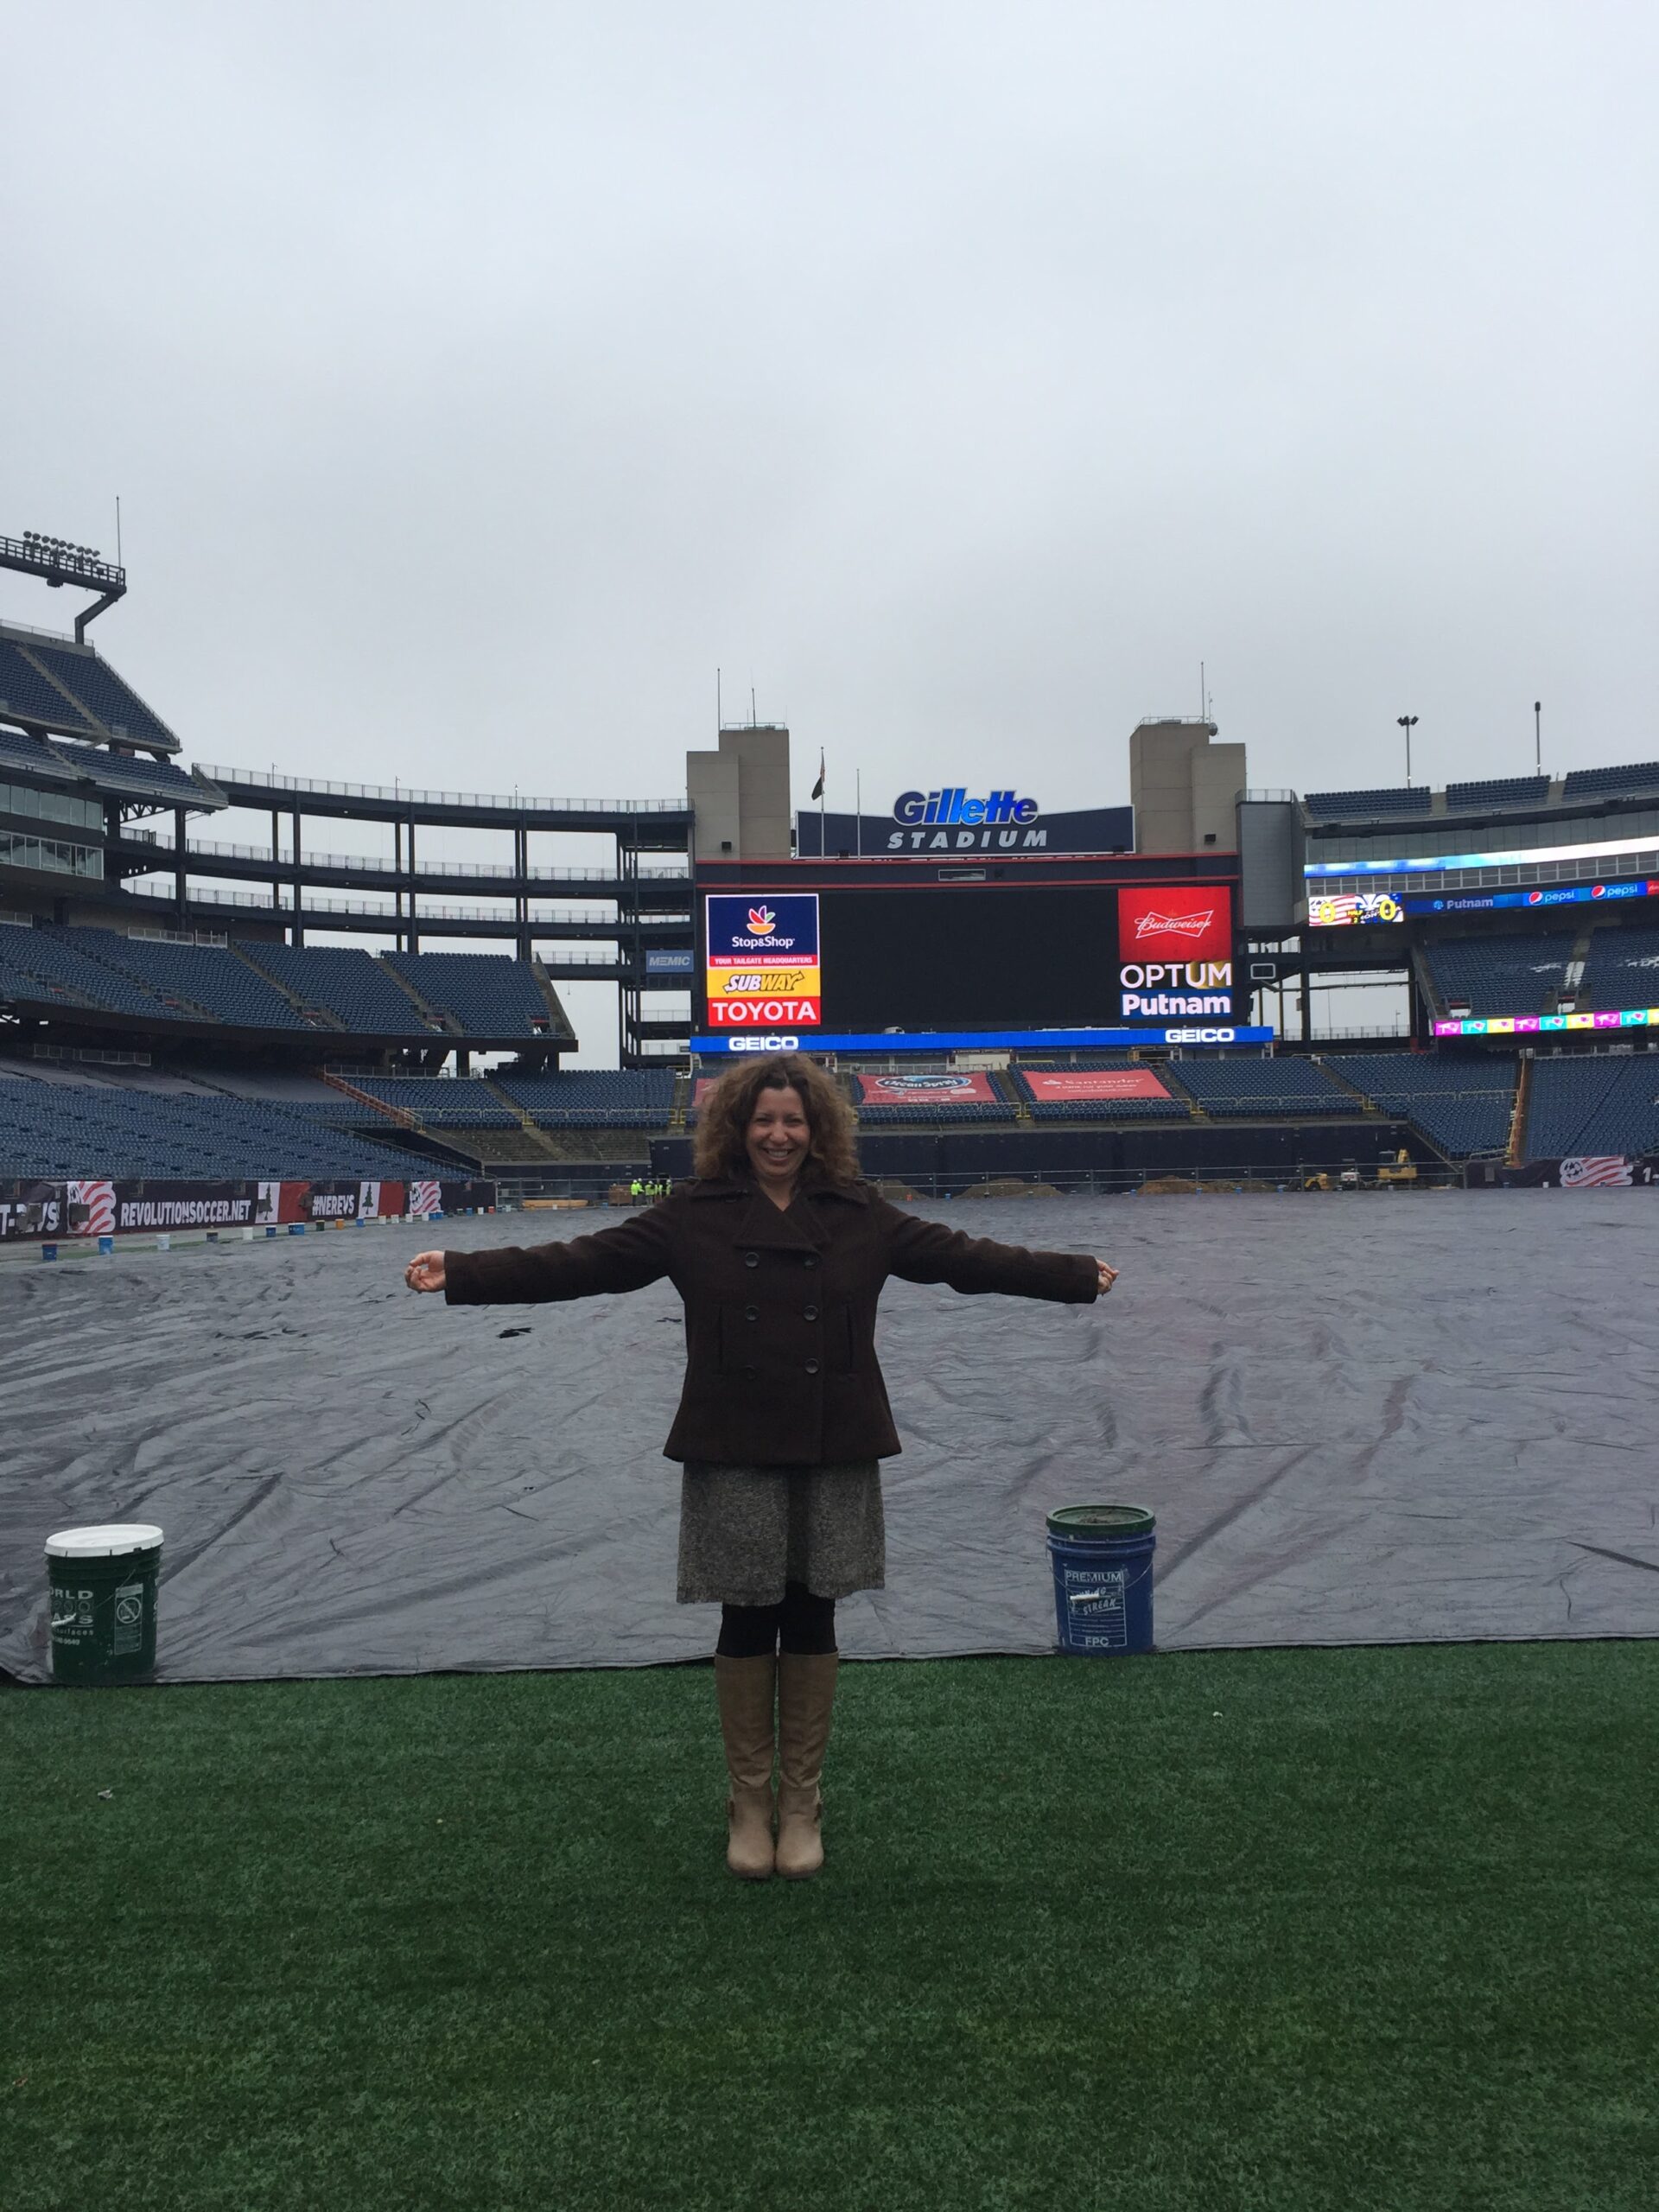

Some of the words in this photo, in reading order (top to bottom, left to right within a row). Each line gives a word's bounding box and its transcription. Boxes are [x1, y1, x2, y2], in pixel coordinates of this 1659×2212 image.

[893, 788, 1038, 825] Gillette
[887, 830, 1047, 849] STADIUM
[1545, 890, 1574, 903] pepsi
[1607, 884, 1637, 898] pepsi
[1446, 899, 1493, 910] Putnam
[1135, 917, 1211, 931] Budweiser
[732, 936, 794, 949] Stop&Shop
[649, 956, 690, 967] MEMIC
[723, 971, 804, 994] SUBWAY
[1120, 963, 1232, 988] OPTUM
[712, 1001, 817, 1021] TOYOTA
[1122, 993, 1230, 1015] Putnam
[728, 1036, 798, 1052] GEICO
[1165, 1028, 1235, 1044] GEICO
[121, 1199, 251, 1227] REVOLUTIONSOCCER.NET
[312, 1194, 355, 1216] #NEREVS
[1065, 1572, 1122, 1582] PREMIUM
[1083, 1599, 1116, 1616] STREAK
[1085, 1637, 1109, 1647] FPC
